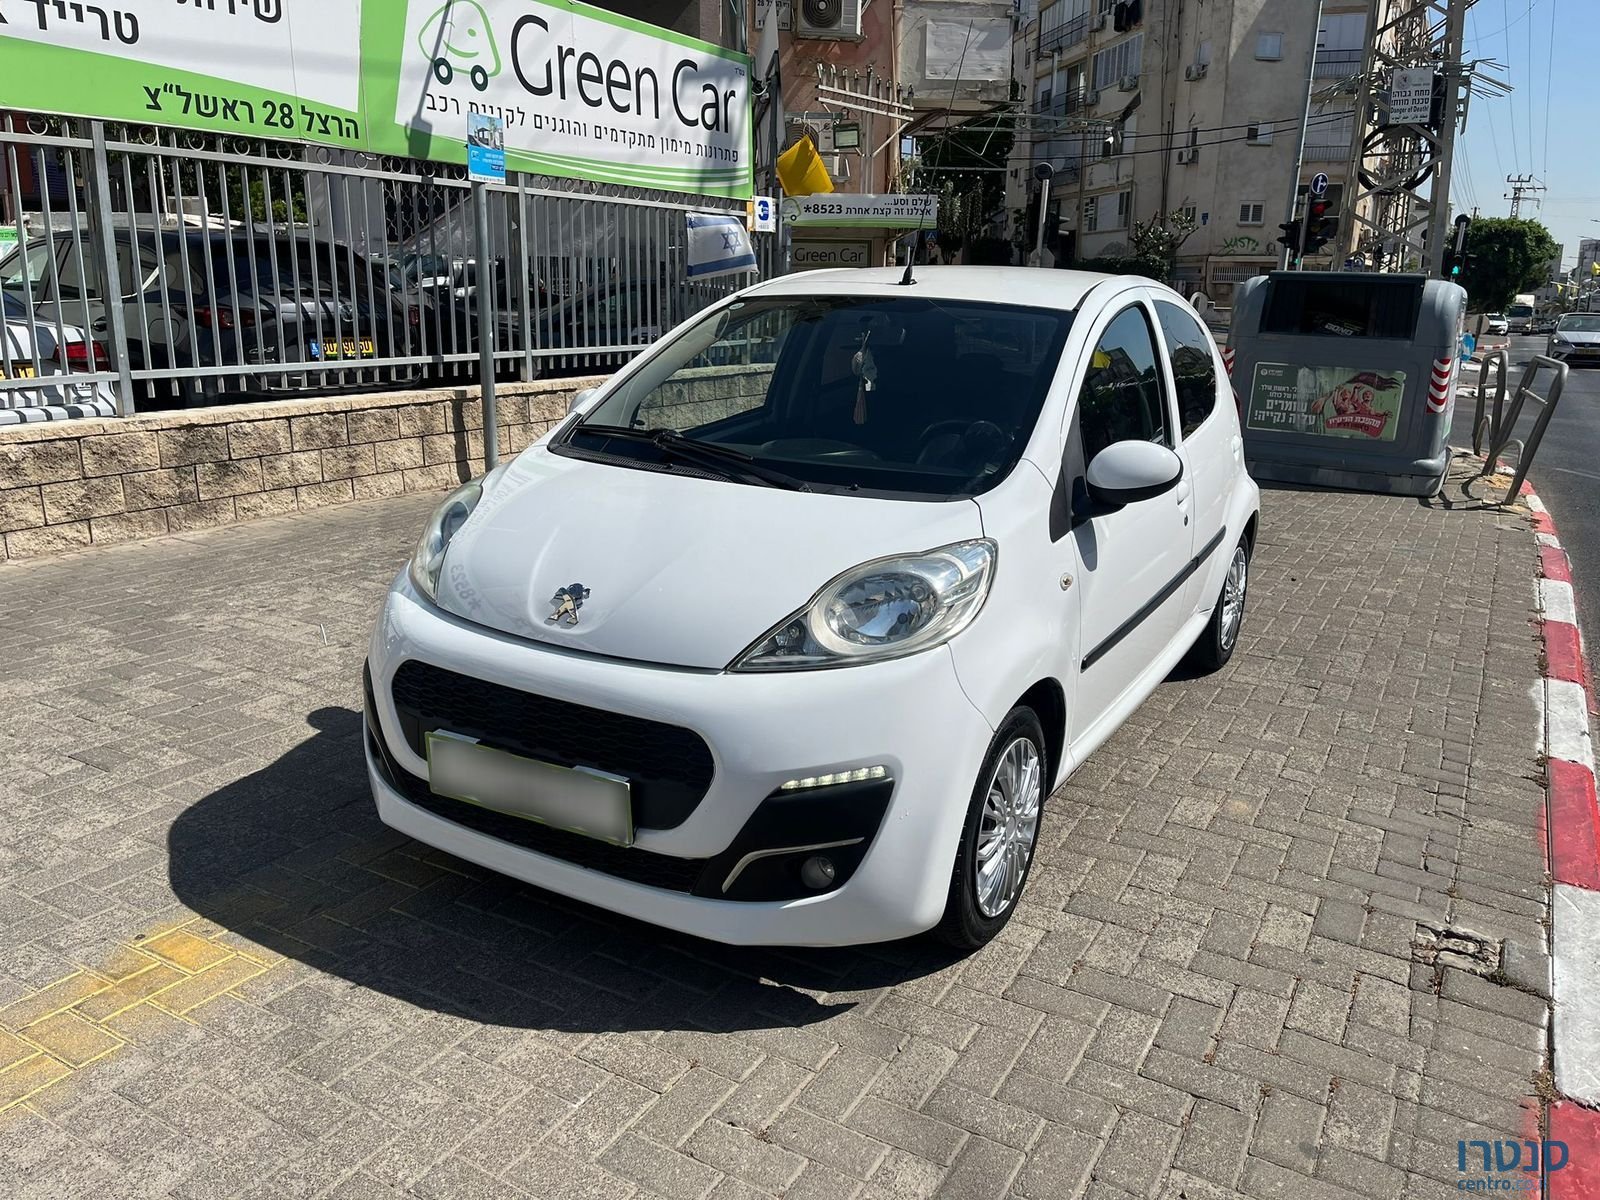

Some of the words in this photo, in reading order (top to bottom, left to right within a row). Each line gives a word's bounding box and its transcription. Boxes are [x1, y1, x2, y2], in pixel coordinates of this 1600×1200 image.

[23, 0, 140, 45] טרייד
[510, 14, 660, 119] Green
[671, 58, 736, 134] Car
[426, 91, 461, 116] רכב
[262, 100, 295, 130] 28
[300, 105, 360, 140] הרצל
[533, 115, 588, 137] והוגנים
[594, 125, 656, 150] מתקדמים
[660, 135, 692, 157] מימון
[696, 143, 740, 163] פתרונות
[845, 206, 870, 215] אחרת
[894, 207, 905, 216] זה
[906, 206, 931, 216] אצלנו
[911, 197, 932, 206] שלם
[872, 207, 892, 217] קצת
[794, 247, 837, 263] Green
[839, 247, 865, 264] Car
[1265, 399, 1308, 412] שומרים
[1253, 410, 1287, 424] נקייה!
